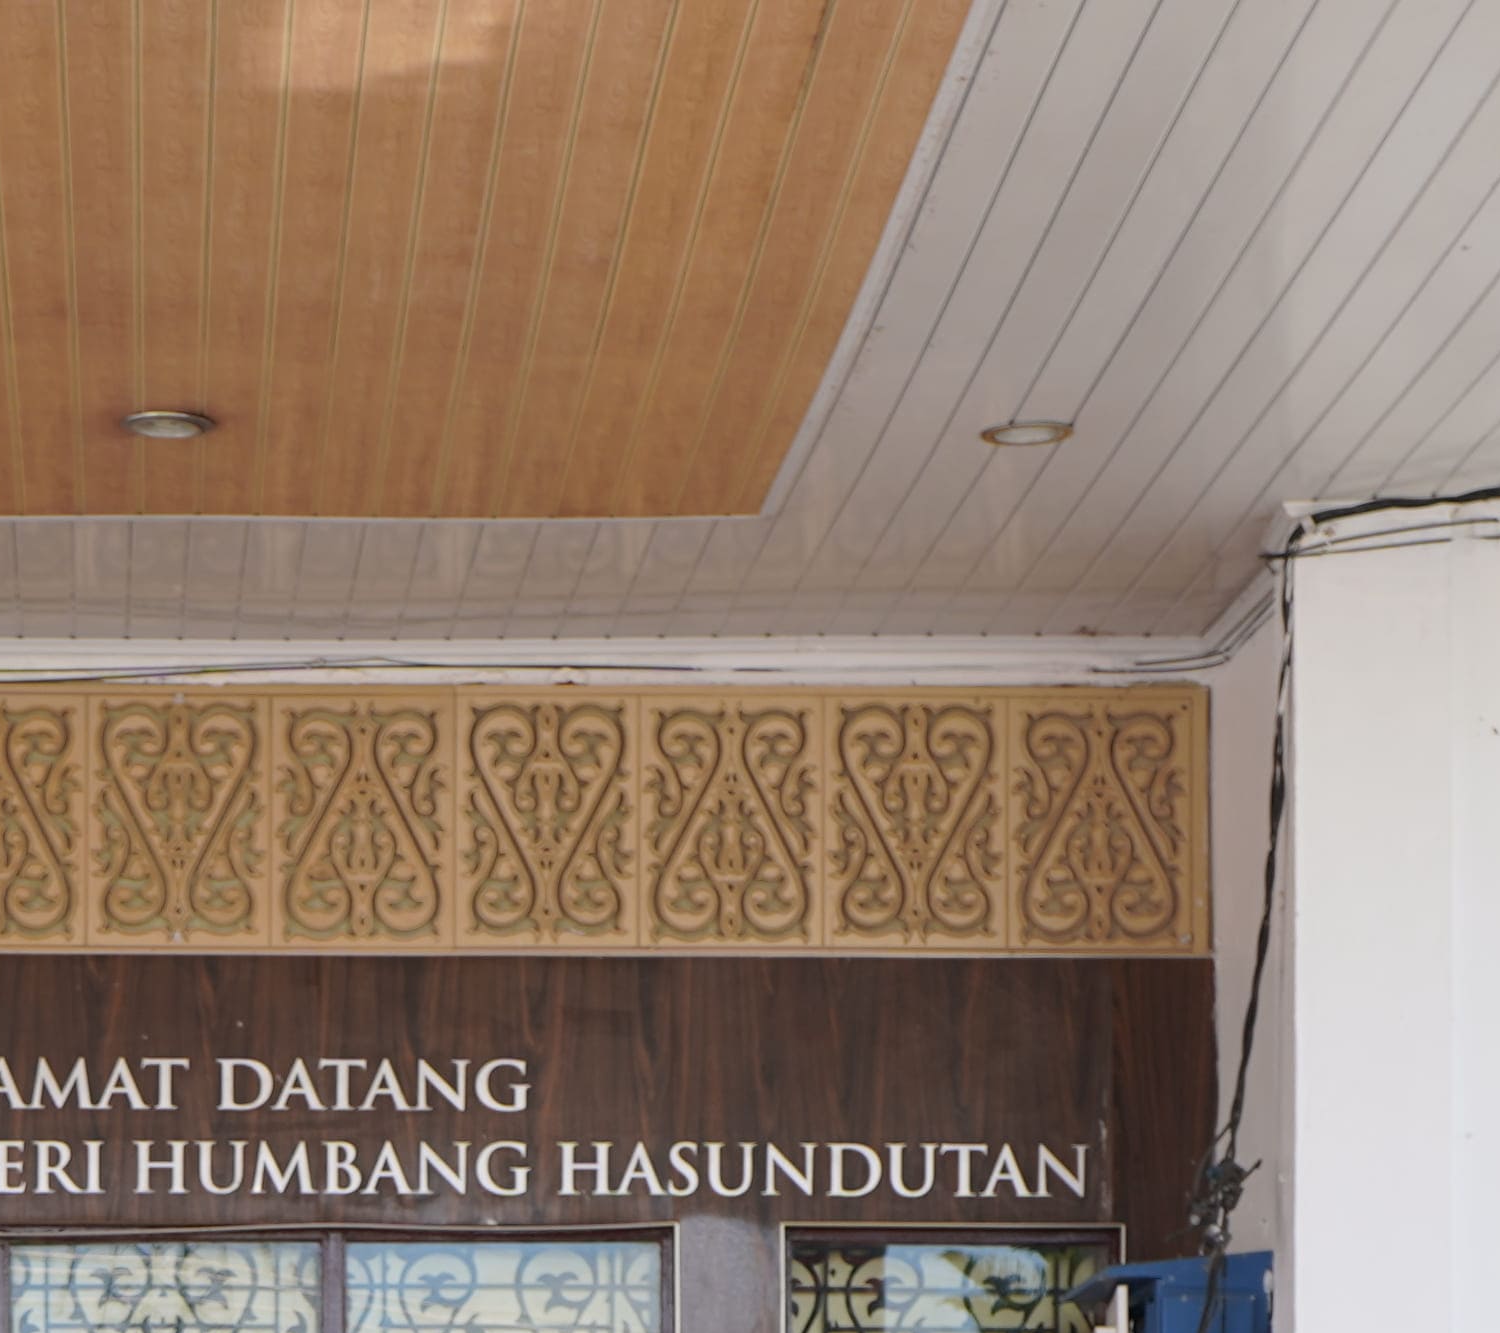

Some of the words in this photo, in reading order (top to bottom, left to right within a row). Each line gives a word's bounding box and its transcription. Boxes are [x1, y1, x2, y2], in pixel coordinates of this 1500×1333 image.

[218, 1059, 529, 1113] DATANG
[135, 1141, 531, 1198] HUMBANG
[559, 1143, 1091, 1199] HASUNDUTAN
